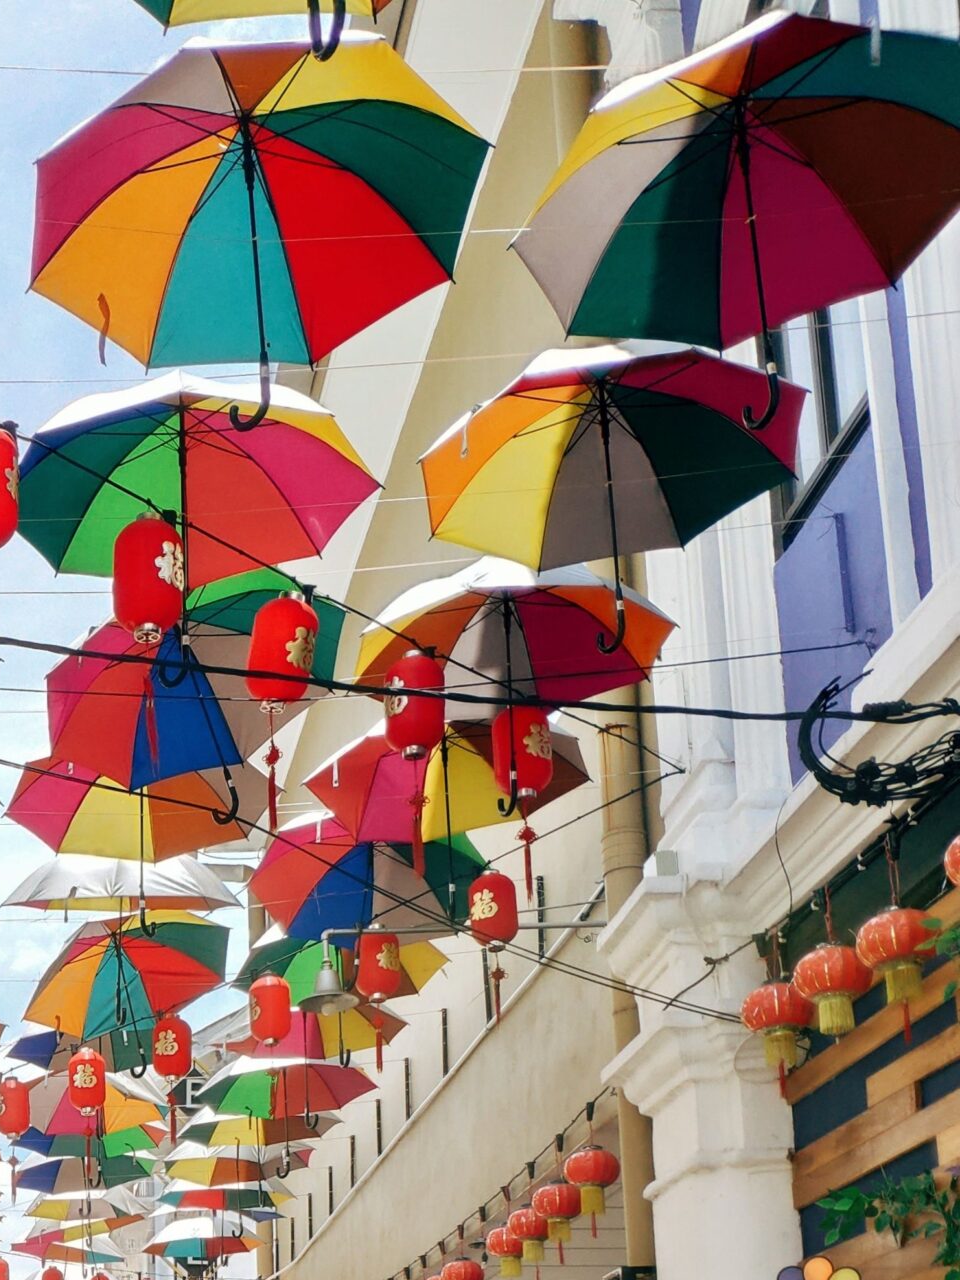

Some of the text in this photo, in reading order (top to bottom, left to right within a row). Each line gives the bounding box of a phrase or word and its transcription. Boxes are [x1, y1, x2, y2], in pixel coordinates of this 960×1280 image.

[154, 540, 184, 591] 福
[522, 723, 552, 760] 福
[471, 888, 498, 921] 福
[155, 1030, 178, 1056] 福
[73, 1063, 98, 1089] 福
